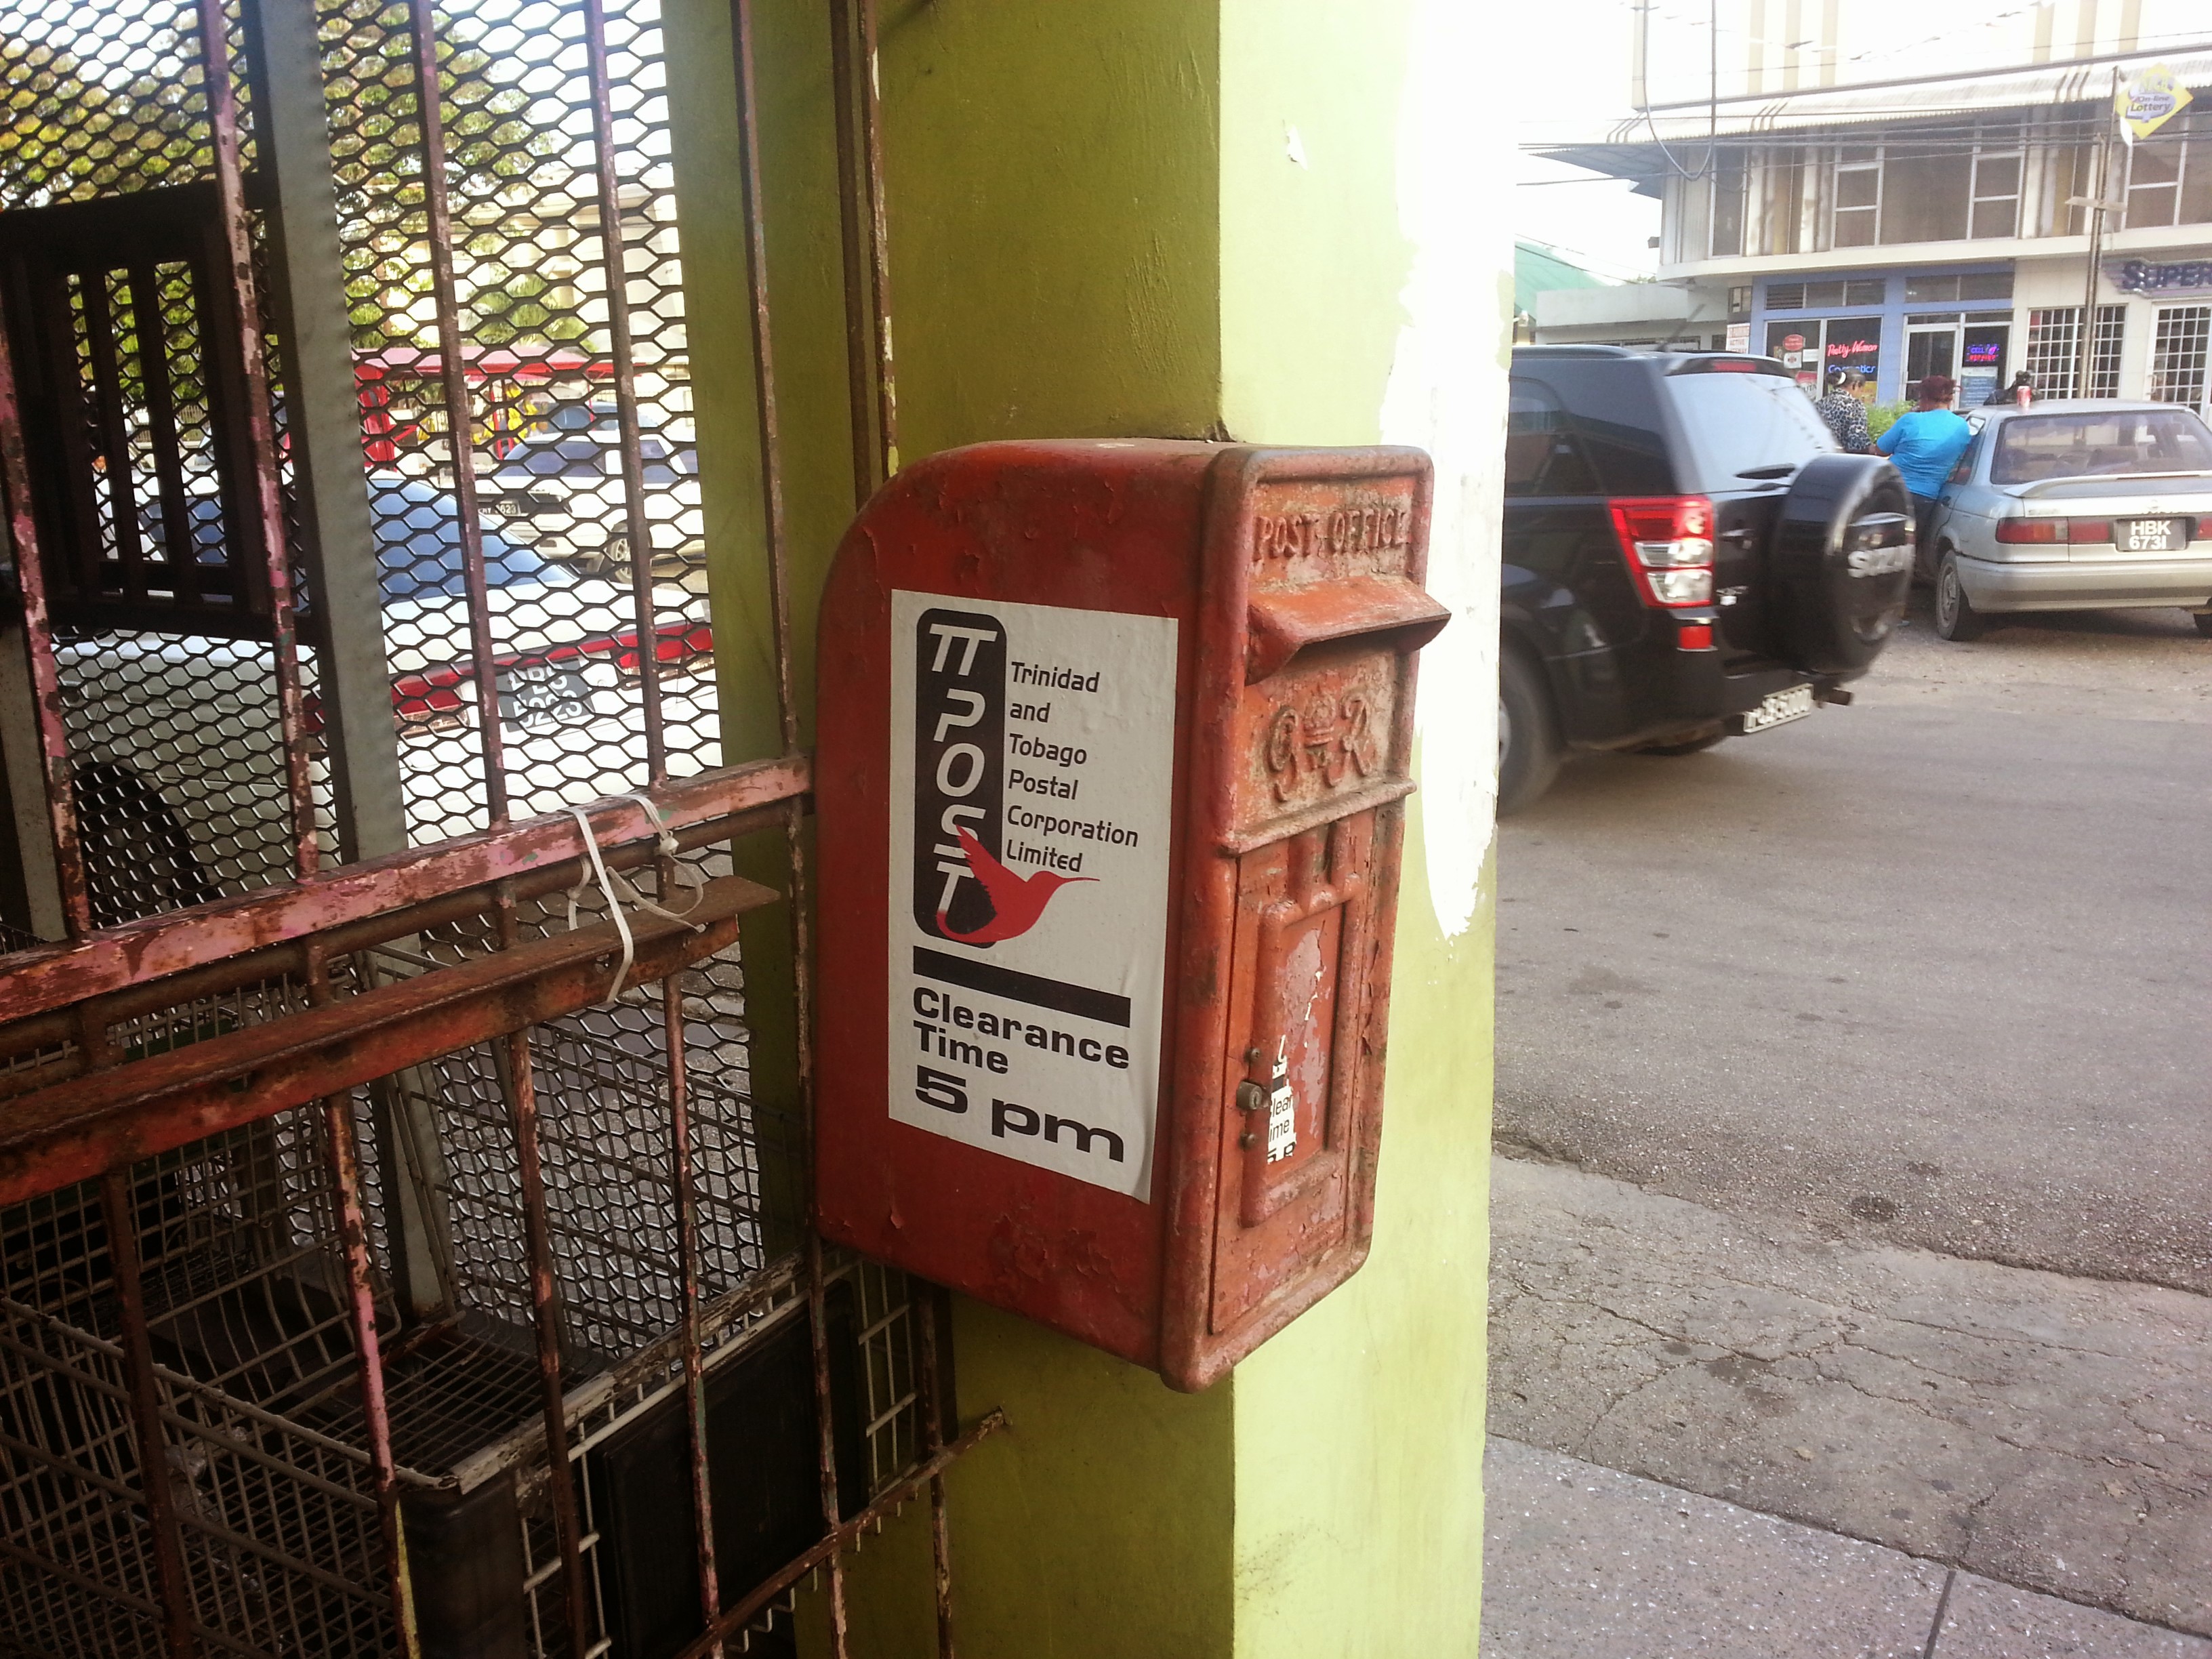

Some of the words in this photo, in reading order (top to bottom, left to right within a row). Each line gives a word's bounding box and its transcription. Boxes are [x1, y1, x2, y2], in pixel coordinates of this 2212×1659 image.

[2130, 102, 2171, 112] Lottery
[1254, 513, 1318, 562] POST
[1327, 508, 1408, 554] OFFICE
[2130, 520, 2171, 536] HBK
[1010, 661, 1101, 693] Trinidad
[1009, 702, 1050, 722] and
[1009, 733, 1087, 768] Tobago
[1008, 769, 1079, 800] Postal
[1007, 804, 1138, 847] Corporation
[1006, 838, 1083, 872] Limited
[913, 987, 1129, 1069] Clearance
[913, 1020, 1009, 1075] Time
[915, 1065, 968, 1114] 5
[991, 1098, 1125, 1164] pm
[1270, 1094, 1294, 1118] lear
